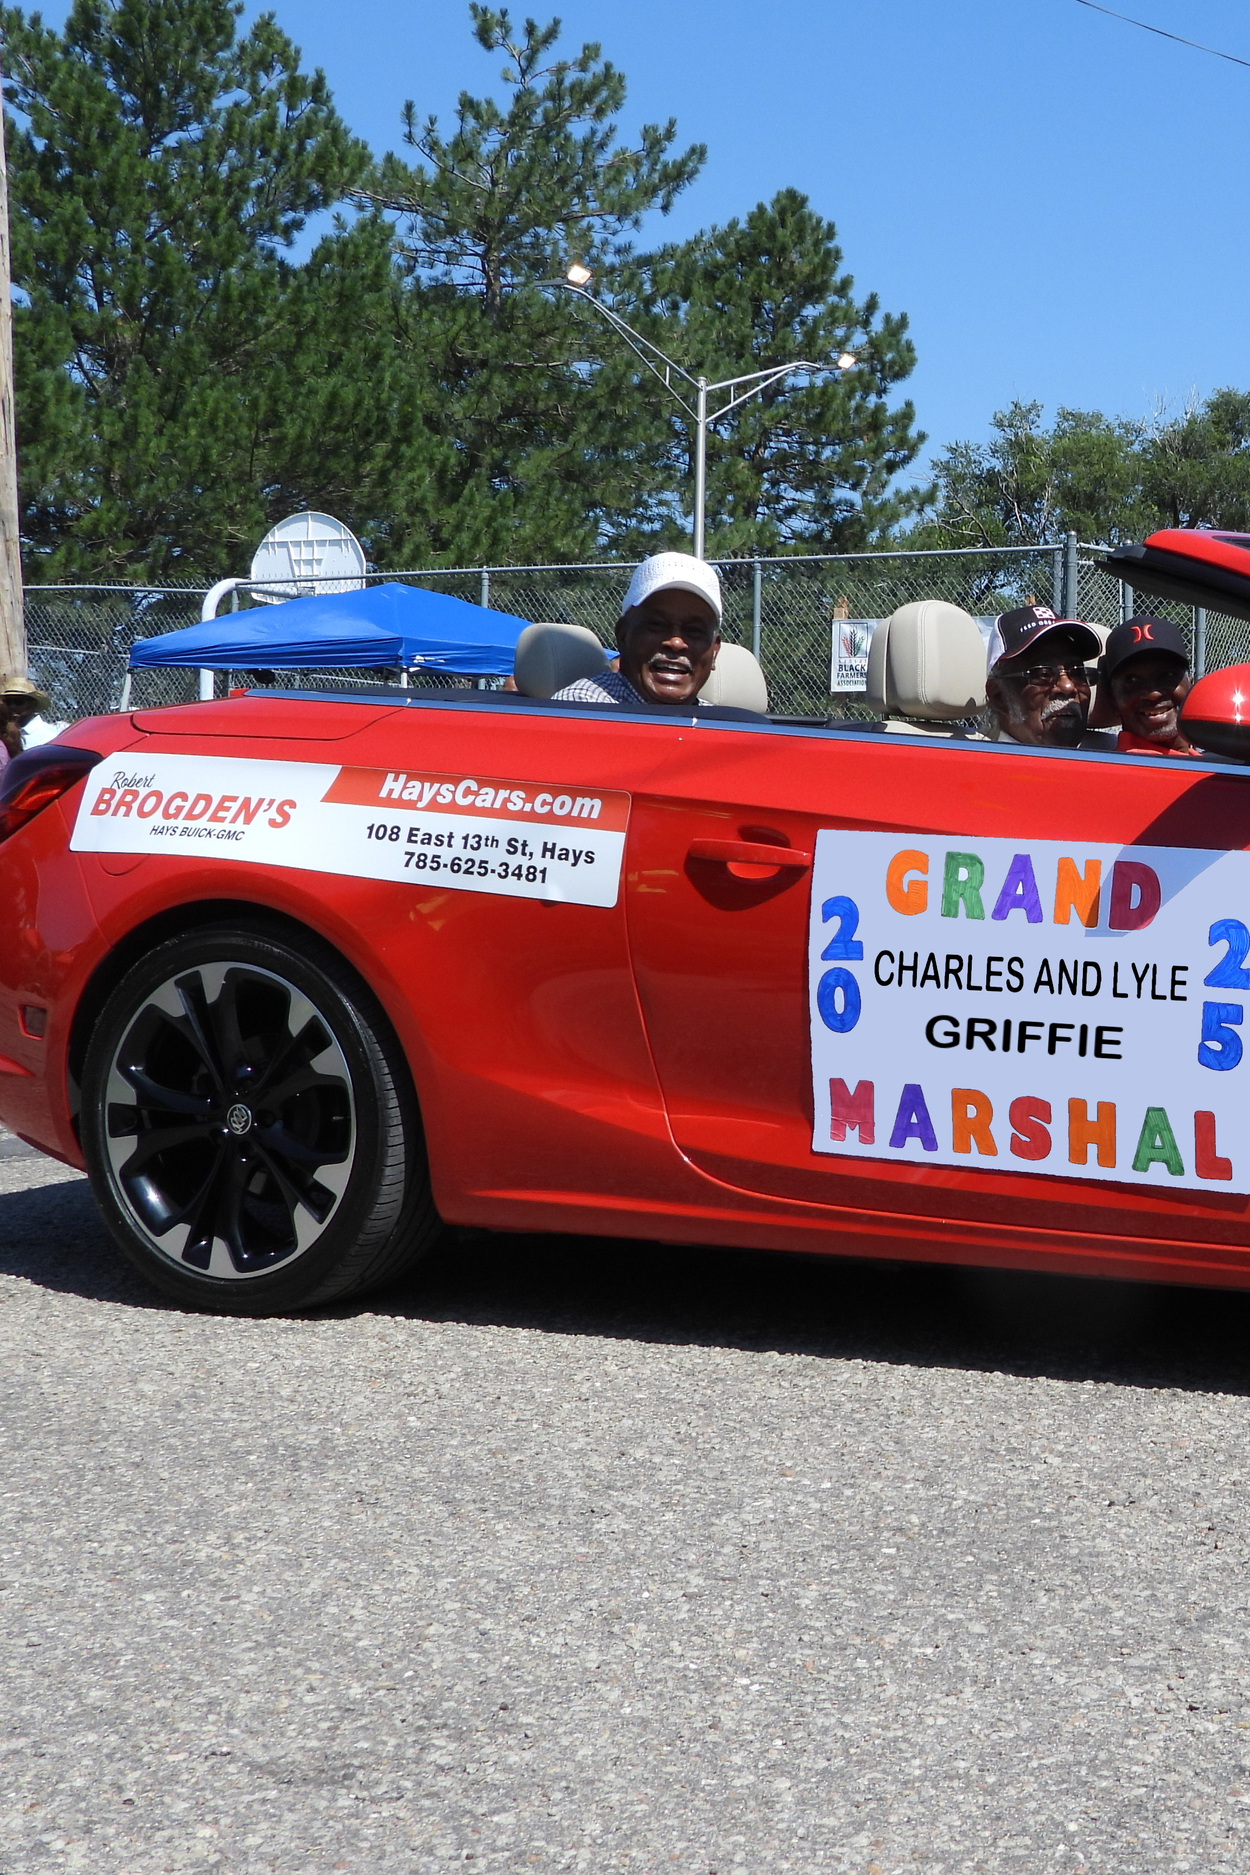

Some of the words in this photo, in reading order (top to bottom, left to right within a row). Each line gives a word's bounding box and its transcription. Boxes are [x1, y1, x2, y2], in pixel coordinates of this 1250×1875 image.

[838, 664, 867, 672] BLACK
[112, 770, 154, 789] Robert
[378, 772, 602, 819] HaysCars.com
[89, 786, 297, 829] BROGDEN'S
[149, 825, 178, 838] HAYS
[179, 827, 245, 842] BUICK-GMC
[365, 823, 401, 842] 108
[406, 827, 455, 849] East
[461, 833, 500, 851] 13th
[505, 837, 534, 861] St,
[540, 841, 596, 868] Hays
[403, 851, 548, 884] 785-625-3481
[886, 849, 1161, 931] GRAND
[874, 949, 1024, 994] CHARLES
[1033, 957, 1102, 998] AND
[1112, 961, 1189, 1002] LYLE
[925, 1014, 1124, 1060] GRIFFIE
[829, 1077, 1233, 1181] MARSHAL
